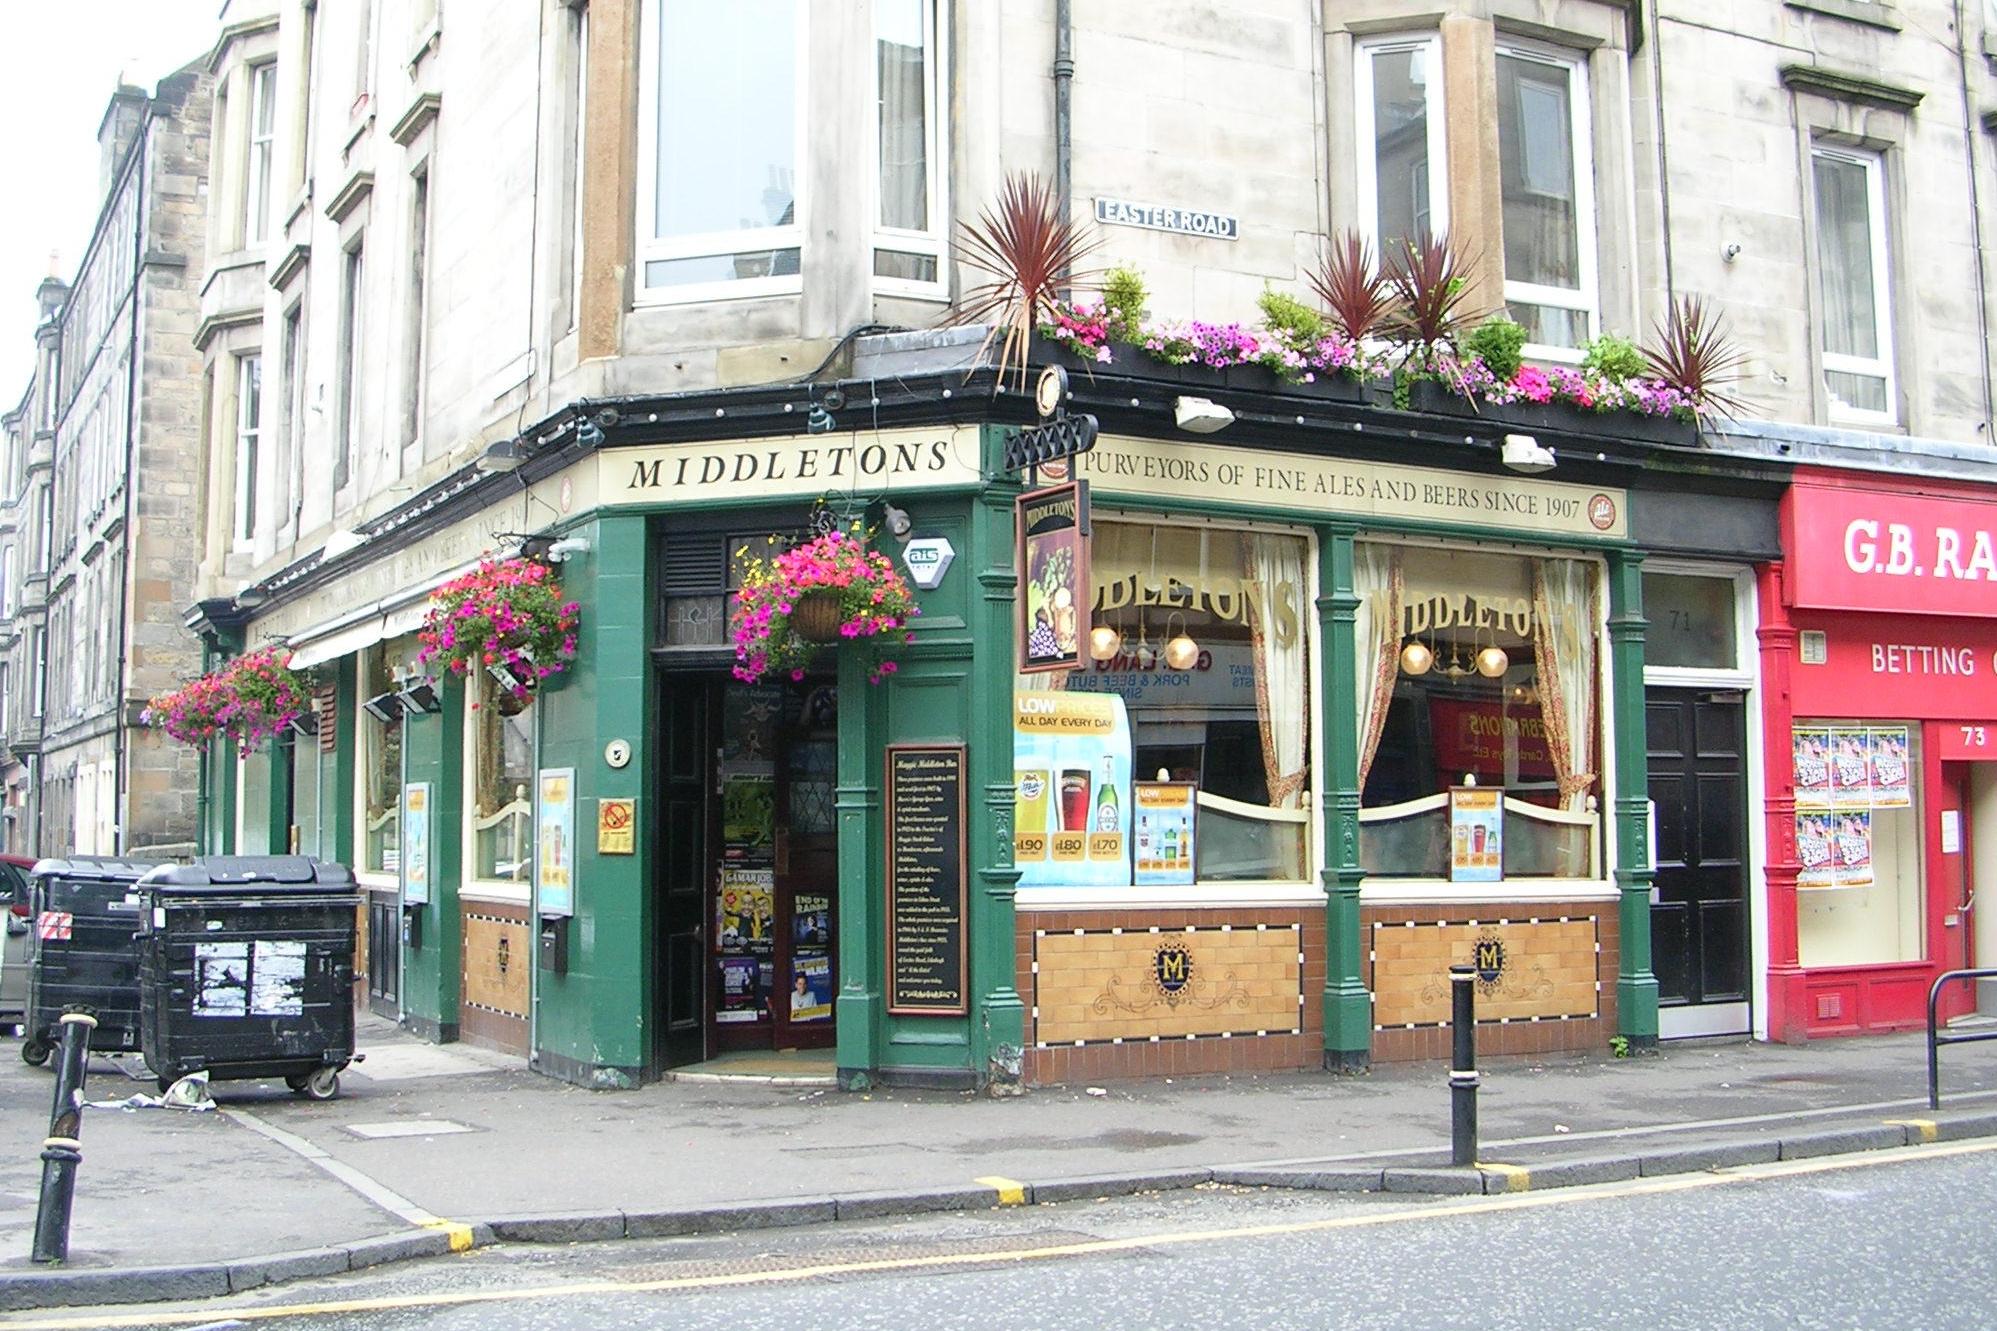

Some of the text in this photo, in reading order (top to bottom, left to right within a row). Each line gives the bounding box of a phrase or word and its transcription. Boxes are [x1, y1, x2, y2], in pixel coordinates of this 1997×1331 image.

[1105, 202, 1231, 236] EASTER ROAD
[627, 440, 949, 490] MIDDLETONS
[1085, 450, 1580, 518] PURVEYORS OF FINE ALES AND BEERS SINCE 1907
[1027, 498, 1077, 531] MIDDLETONS
[1844, 518, 1922, 577] G.B.
[1370, 589, 1579, 661] MIDDLETONS
[1669, 610, 1691, 632] 71
[1872, 643, 1975, 676] BETTING
[1017, 697, 1056, 715] LOW
[1018, 716, 1113, 728] ALL DAY EVERY DAY
[1960, 726, 1986, 747] 73
[1163, 954, 1185, 980] M
[1480, 944, 1498, 969] M
